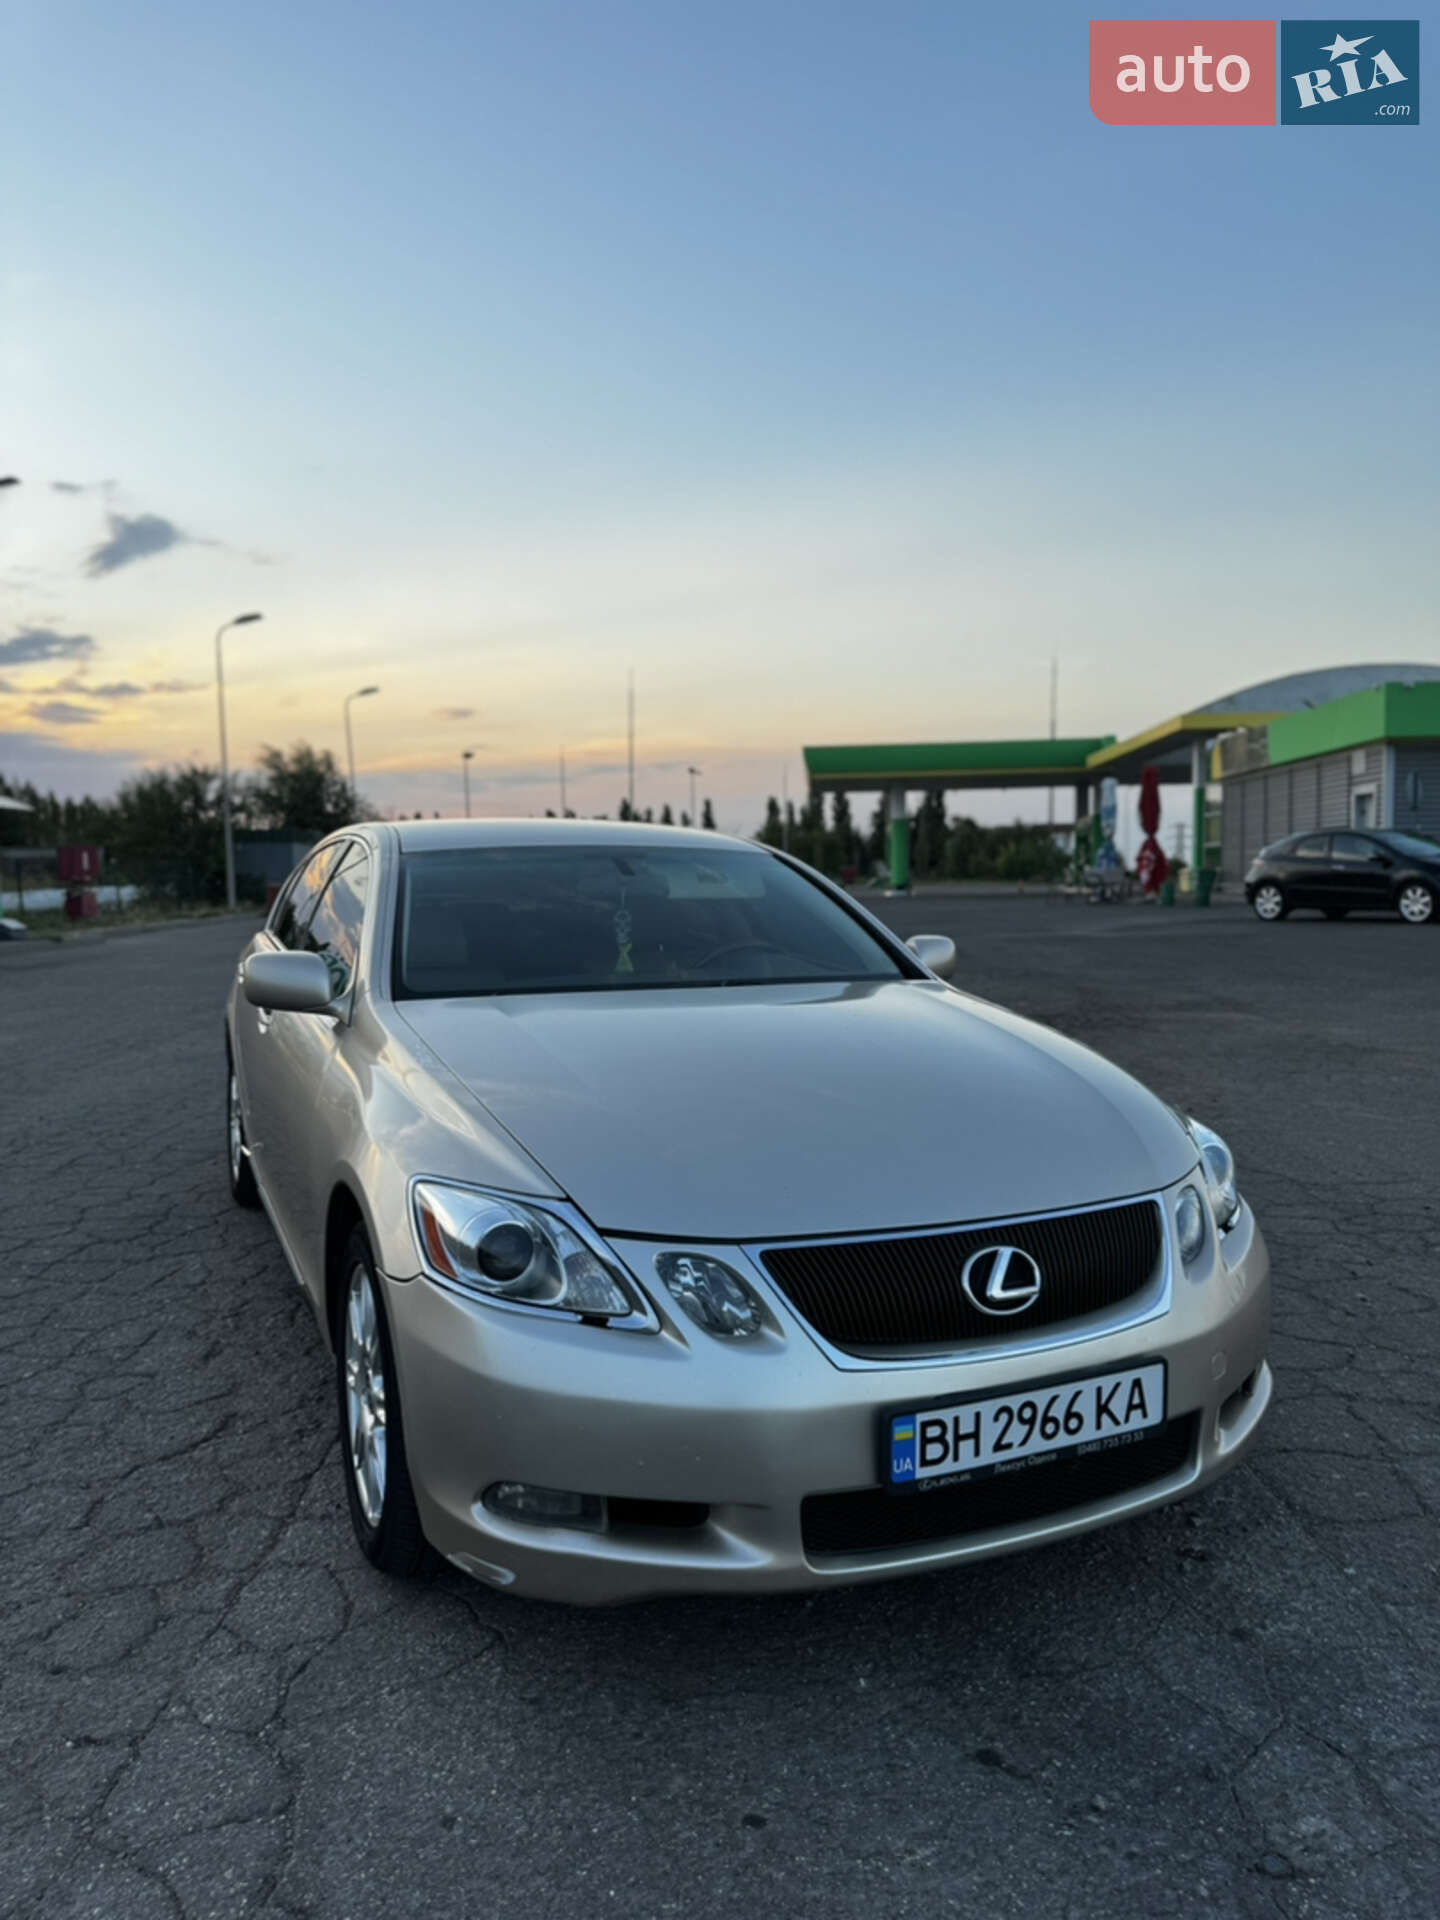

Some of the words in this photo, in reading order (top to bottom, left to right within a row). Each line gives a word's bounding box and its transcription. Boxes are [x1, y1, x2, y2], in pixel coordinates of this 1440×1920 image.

[919, 1411, 981, 1468] BH
[992, 1390, 1083, 1453] 2966
[1095, 1377, 1149, 1432] KA
[893, 1457, 914, 1473] UA
